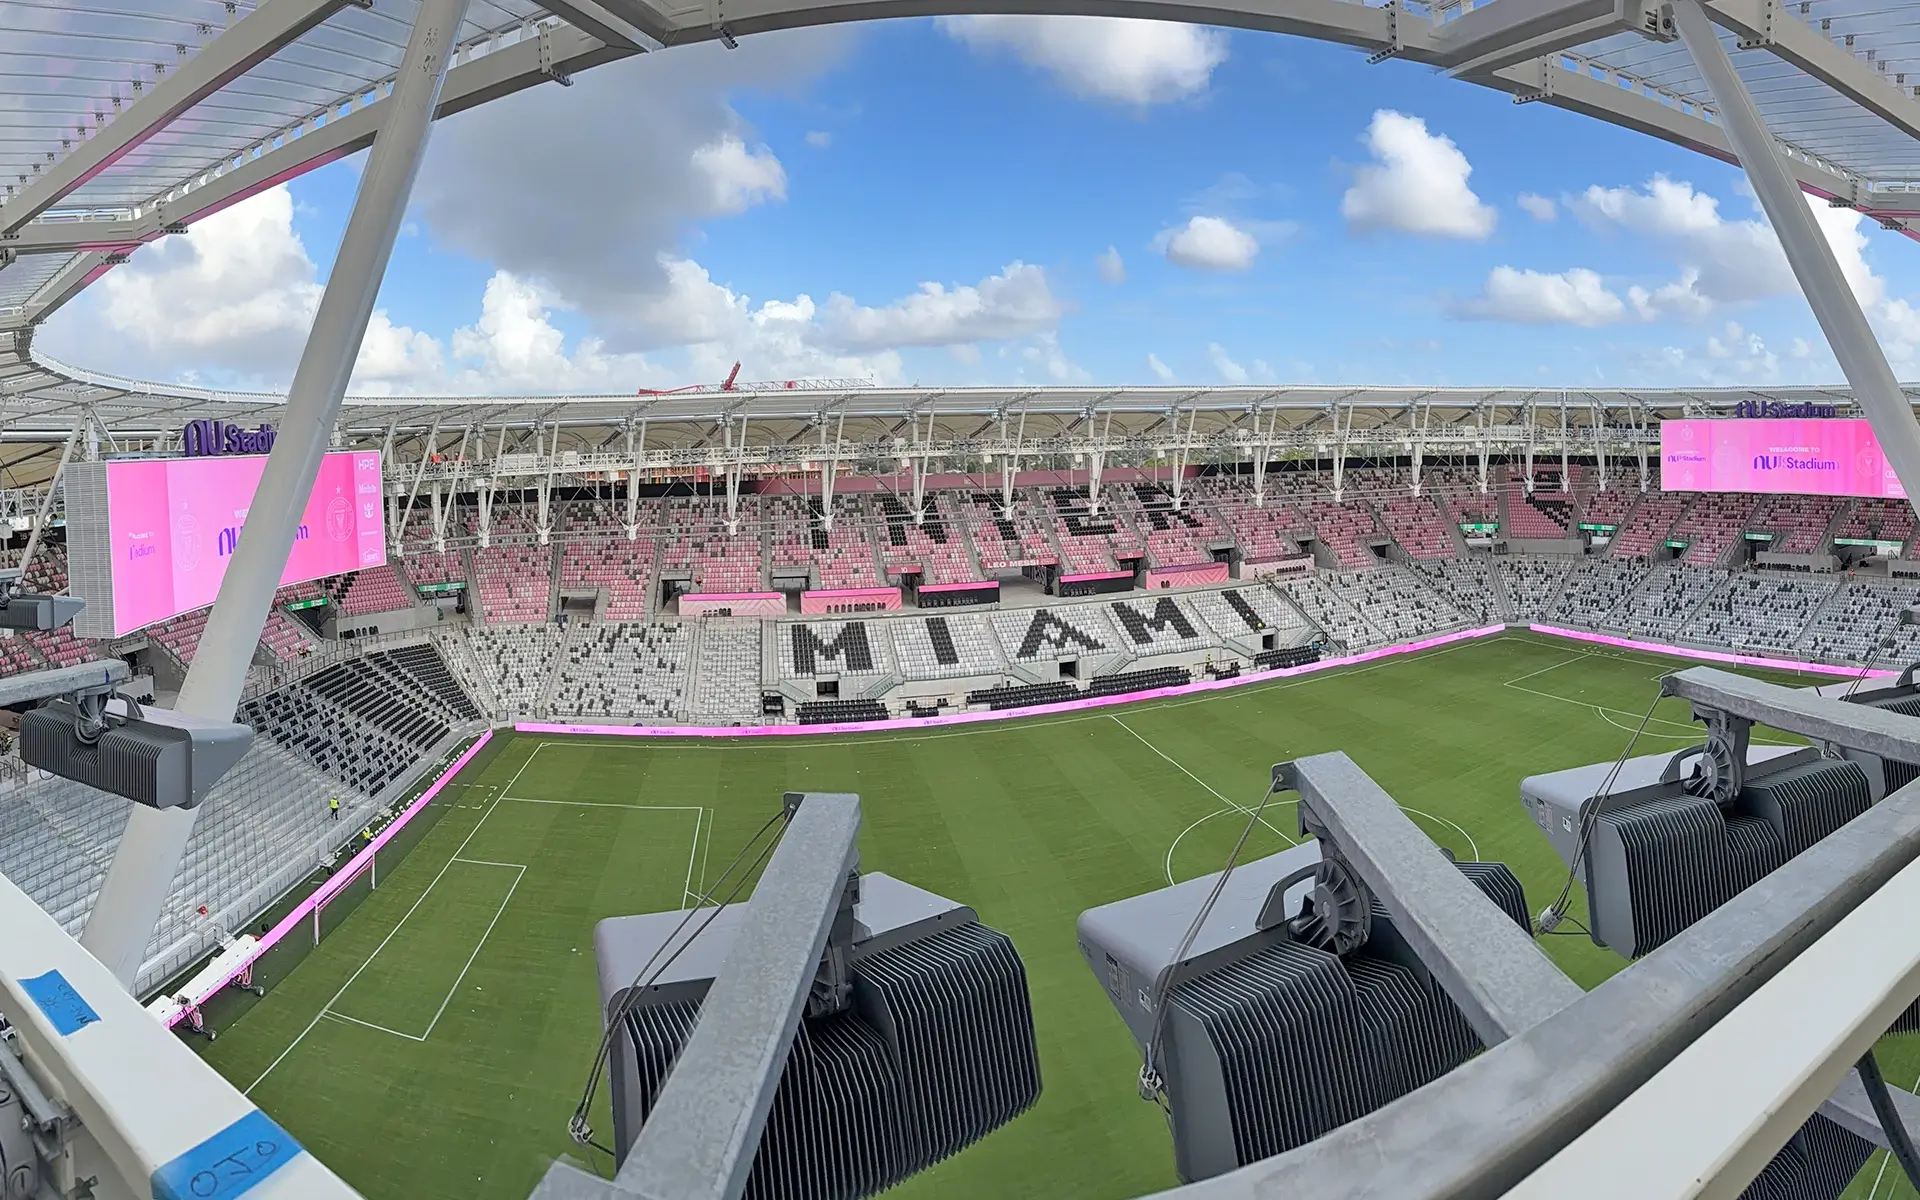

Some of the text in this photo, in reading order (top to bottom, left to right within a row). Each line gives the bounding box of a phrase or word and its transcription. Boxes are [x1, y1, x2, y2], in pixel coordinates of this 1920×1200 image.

[1768, 401, 1836, 418] Stadium
[225, 423, 276, 453] Stadi
[1786, 457, 1835, 470] Stadium
[1009, 559, 1039, 567] MESSI
